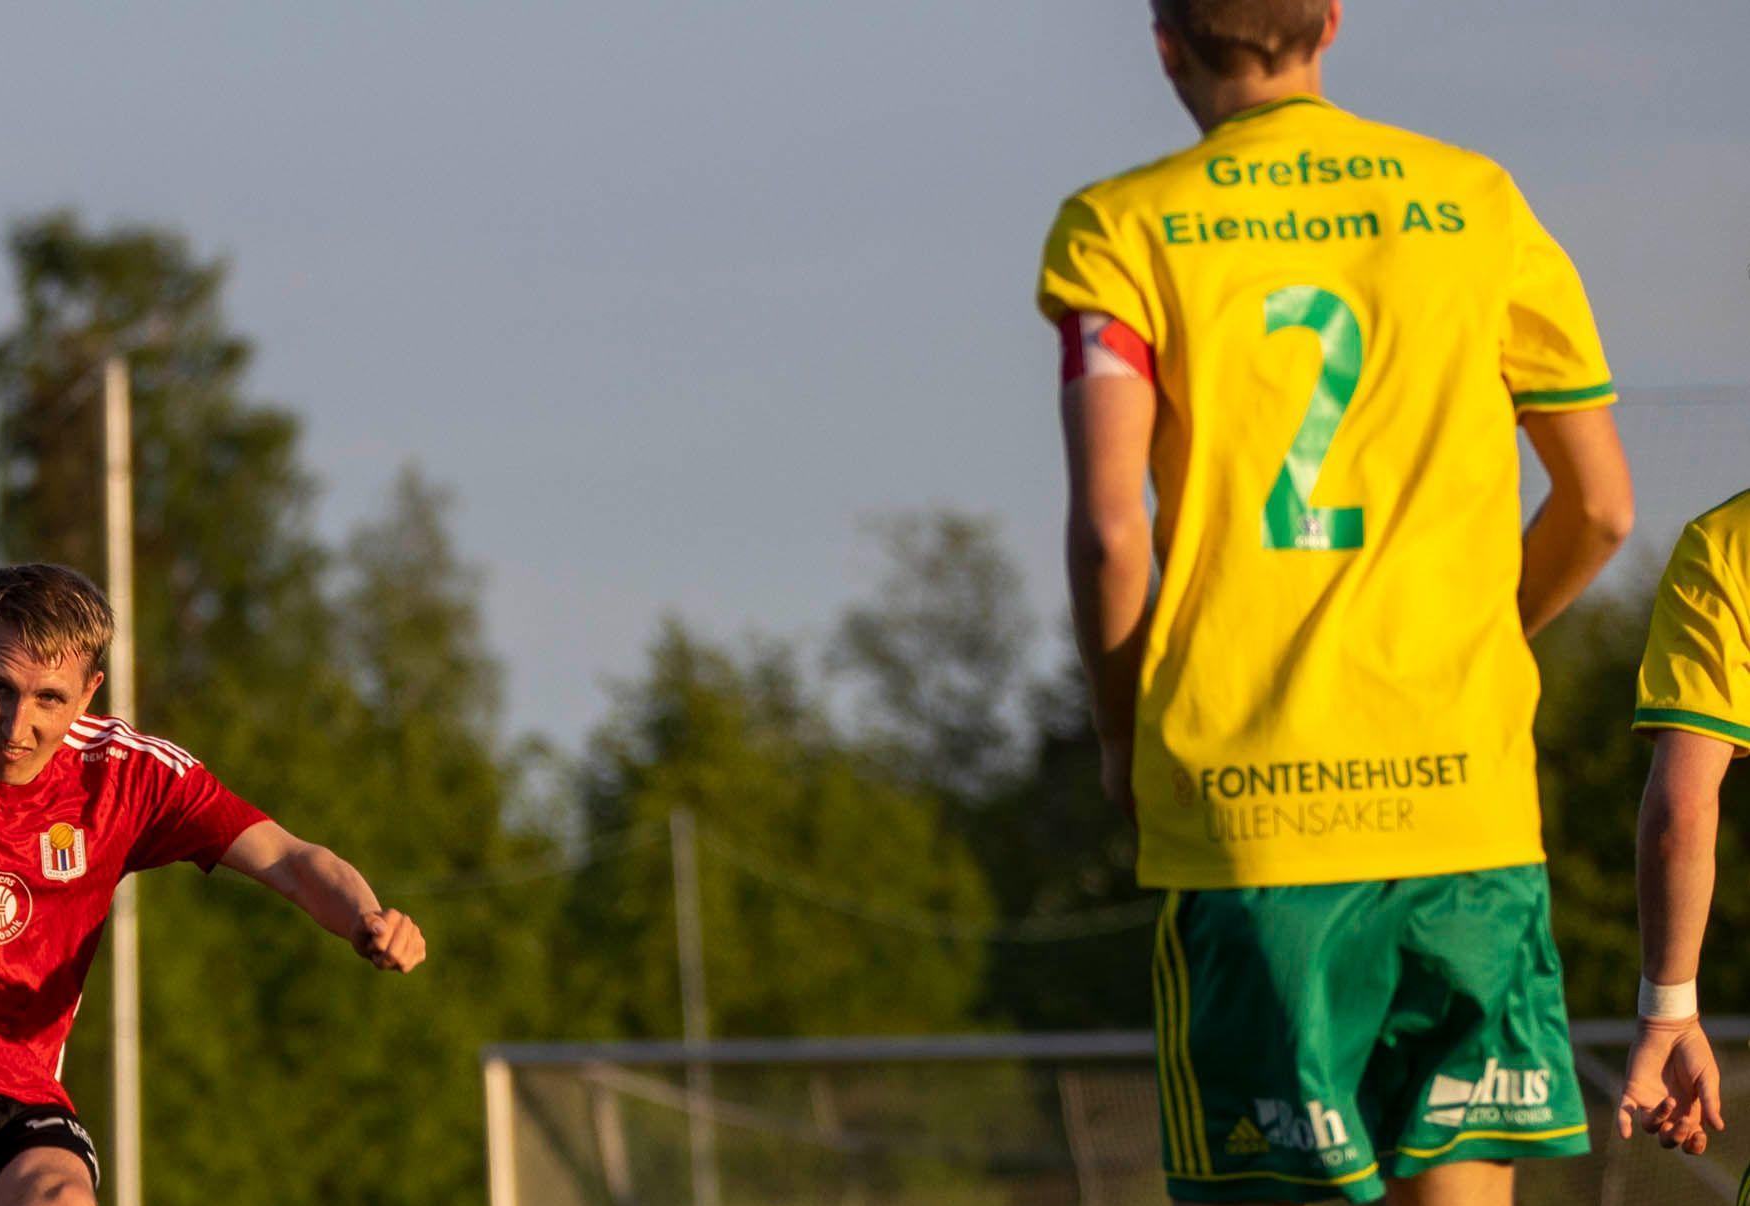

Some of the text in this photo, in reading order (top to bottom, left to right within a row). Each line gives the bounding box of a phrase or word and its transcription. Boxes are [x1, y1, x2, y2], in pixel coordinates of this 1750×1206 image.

[1206, 151, 1406, 187] Grefsen
[1161, 199, 1467, 245] Eiendom AS
[1260, 284, 1366, 550] 2
[1200, 752, 1469, 801] FONTENEHUSET
[1205, 797, 1416, 844] ULLENSAKER
